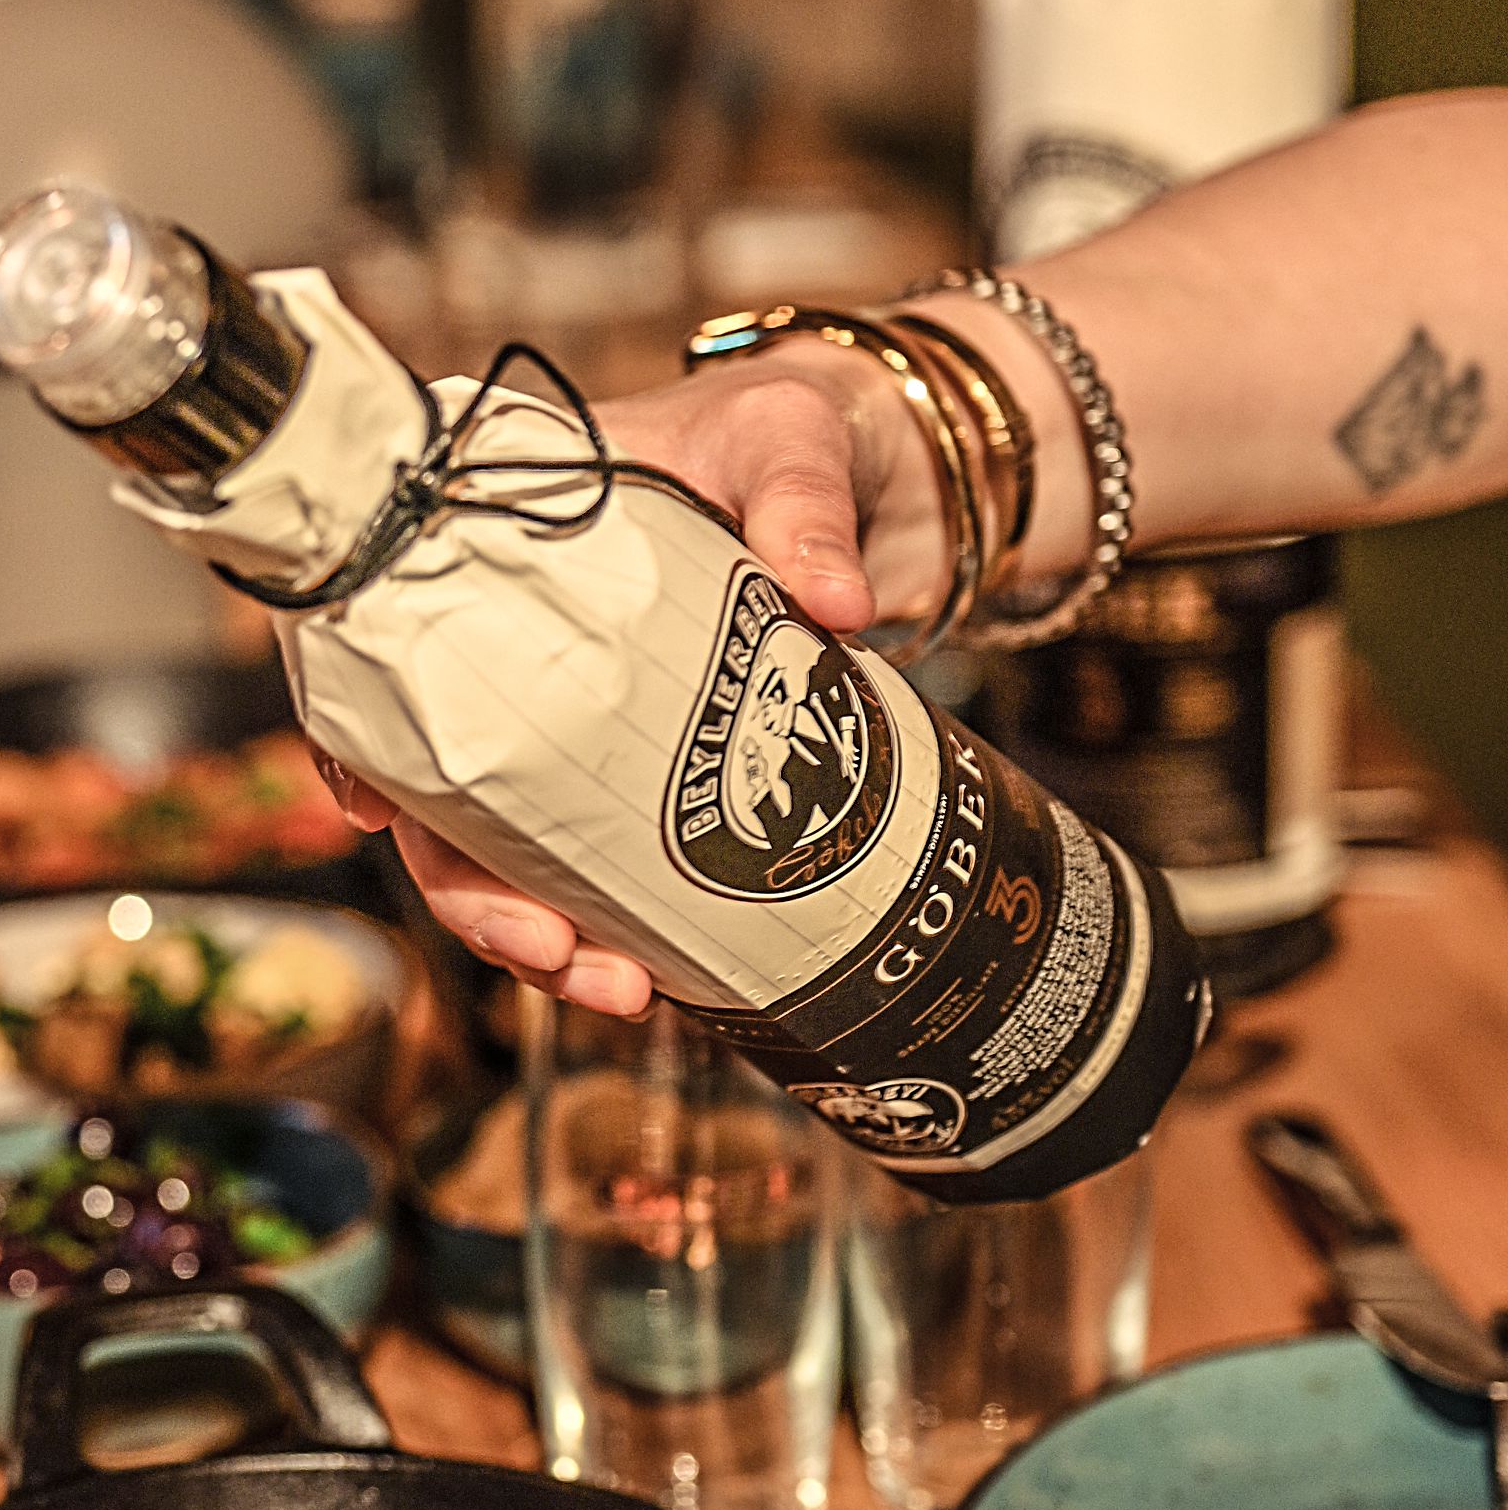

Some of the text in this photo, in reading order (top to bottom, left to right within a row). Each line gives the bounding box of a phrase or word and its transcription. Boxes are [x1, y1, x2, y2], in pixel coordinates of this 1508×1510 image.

[873, 732, 985, 985] GÖBEK
[929, 793, 948, 849] DISTILLERY
[984, 867, 1042, 945] 3
